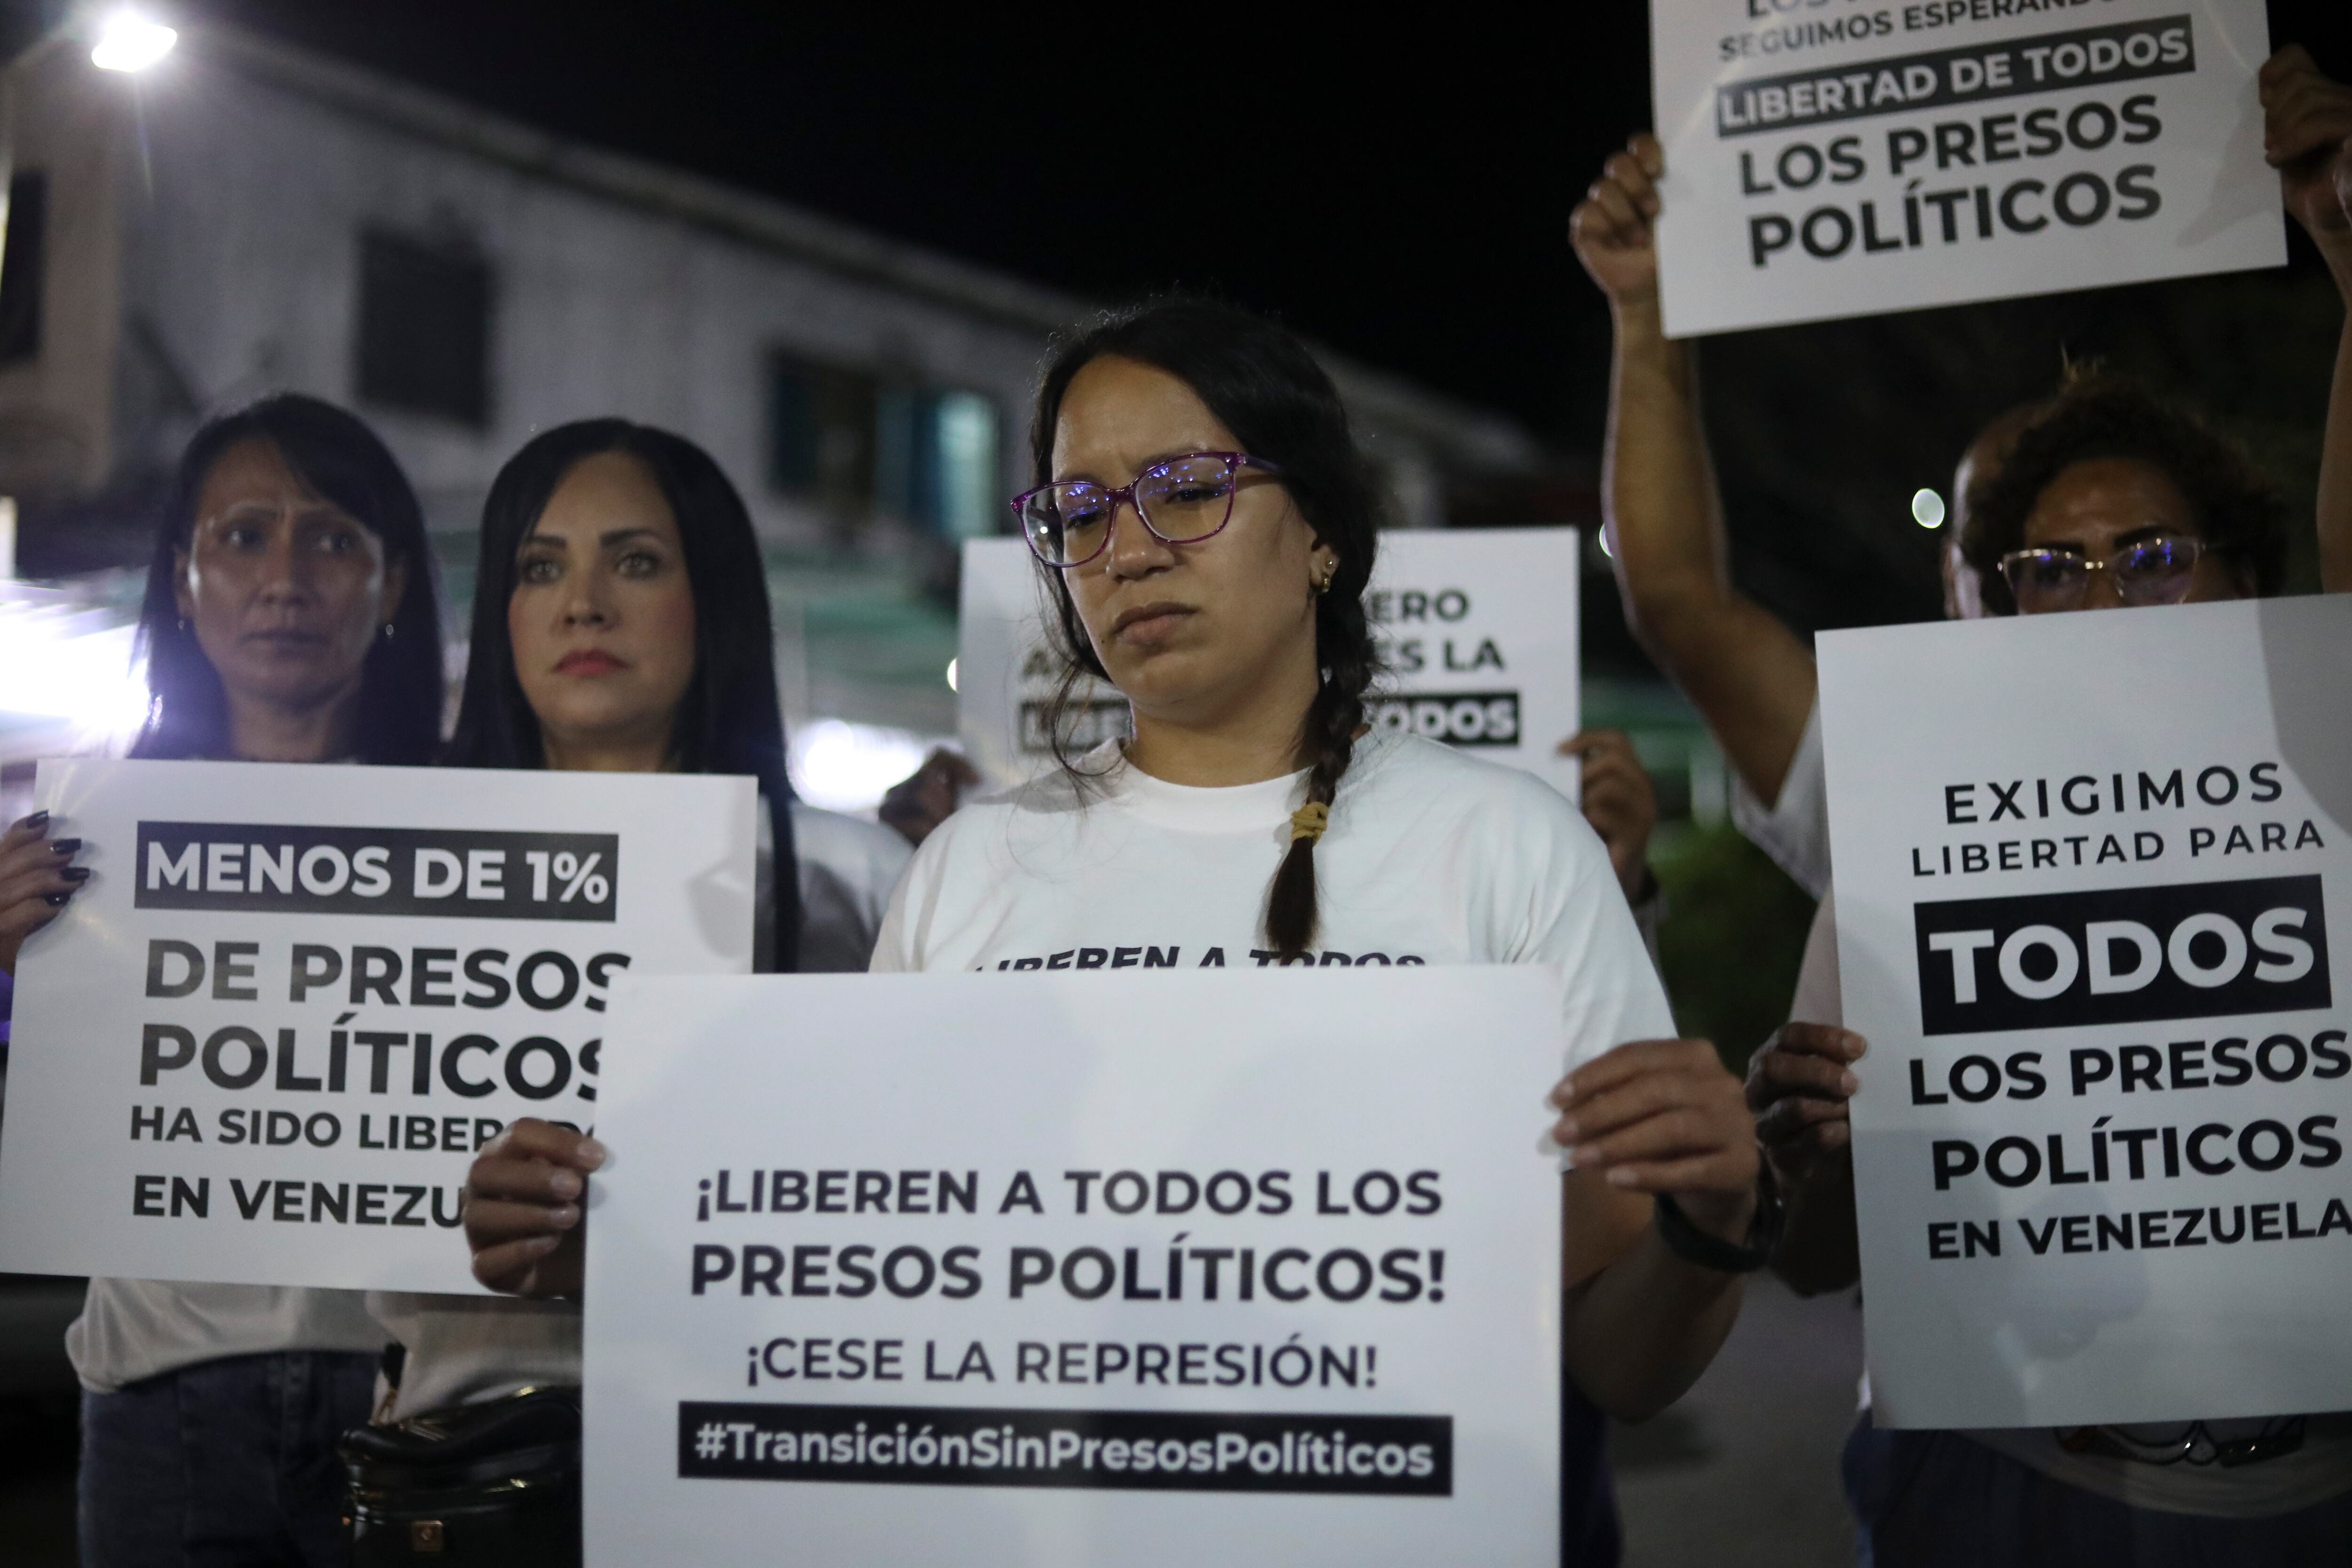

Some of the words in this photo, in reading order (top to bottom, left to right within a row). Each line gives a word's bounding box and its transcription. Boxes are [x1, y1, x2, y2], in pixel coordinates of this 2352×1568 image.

[1719, 9, 1895, 62] SEGUIMOS
[1720, 64, 1937, 128] LIBERTAD
[1949, 52, 2013, 93] DE
[2022, 28, 2189, 81] TODOS
[1739, 135, 1867, 196] LOS
[1888, 94, 2162, 175] PRESOS
[1748, 163, 2162, 267] POLÍTICOS
[1444, 638, 1505, 673] LA
[1944, 761, 2283, 825] EXIGIMOS
[146, 841, 392, 898] MENOS
[413, 848, 506, 899] DE
[525, 851, 609, 904] 1%
[1911, 830, 2165, 877] LIBERTAD
[2189, 819, 2325, 858] PARA
[144, 939, 260, 1001] DE
[289, 943, 632, 1012] PRESOS
[1928, 906, 2314, 1004] TODOS
[1908, 1051, 2048, 1106] LOS
[2069, 1029, 2352, 1097] PRESOS
[129, 1105, 203, 1143] HA
[217, 1108, 342, 1149] SIDO
[358, 1113, 594, 1152] LIBER
[1931, 1114, 2343, 1192] POLÍTICOS
[132, 1174, 210, 1218] EN
[229, 1178, 462, 1228] VENEZU
[697, 1169, 978, 1223] ¡LIBEREN
[998, 1170, 1044, 1215] A
[1063, 1170, 1294, 1217] TODOS
[1316, 1170, 1443, 1217] LOS
[1927, 1219, 2002, 1260] EN
[2017, 1197, 2352, 1256] VENEZUELA
[690, 1243, 983, 1300] PRESOS
[1008, 1232, 1446, 1304] POLÍTICOS!
[747, 1337, 904, 1388] ¡CESE
[923, 1339, 996, 1383] LA
[1015, 1332, 1377, 1389] REPRESIÓN!
[695, 1421, 1435, 1477] #TransiciónSinPresosPolíticos
